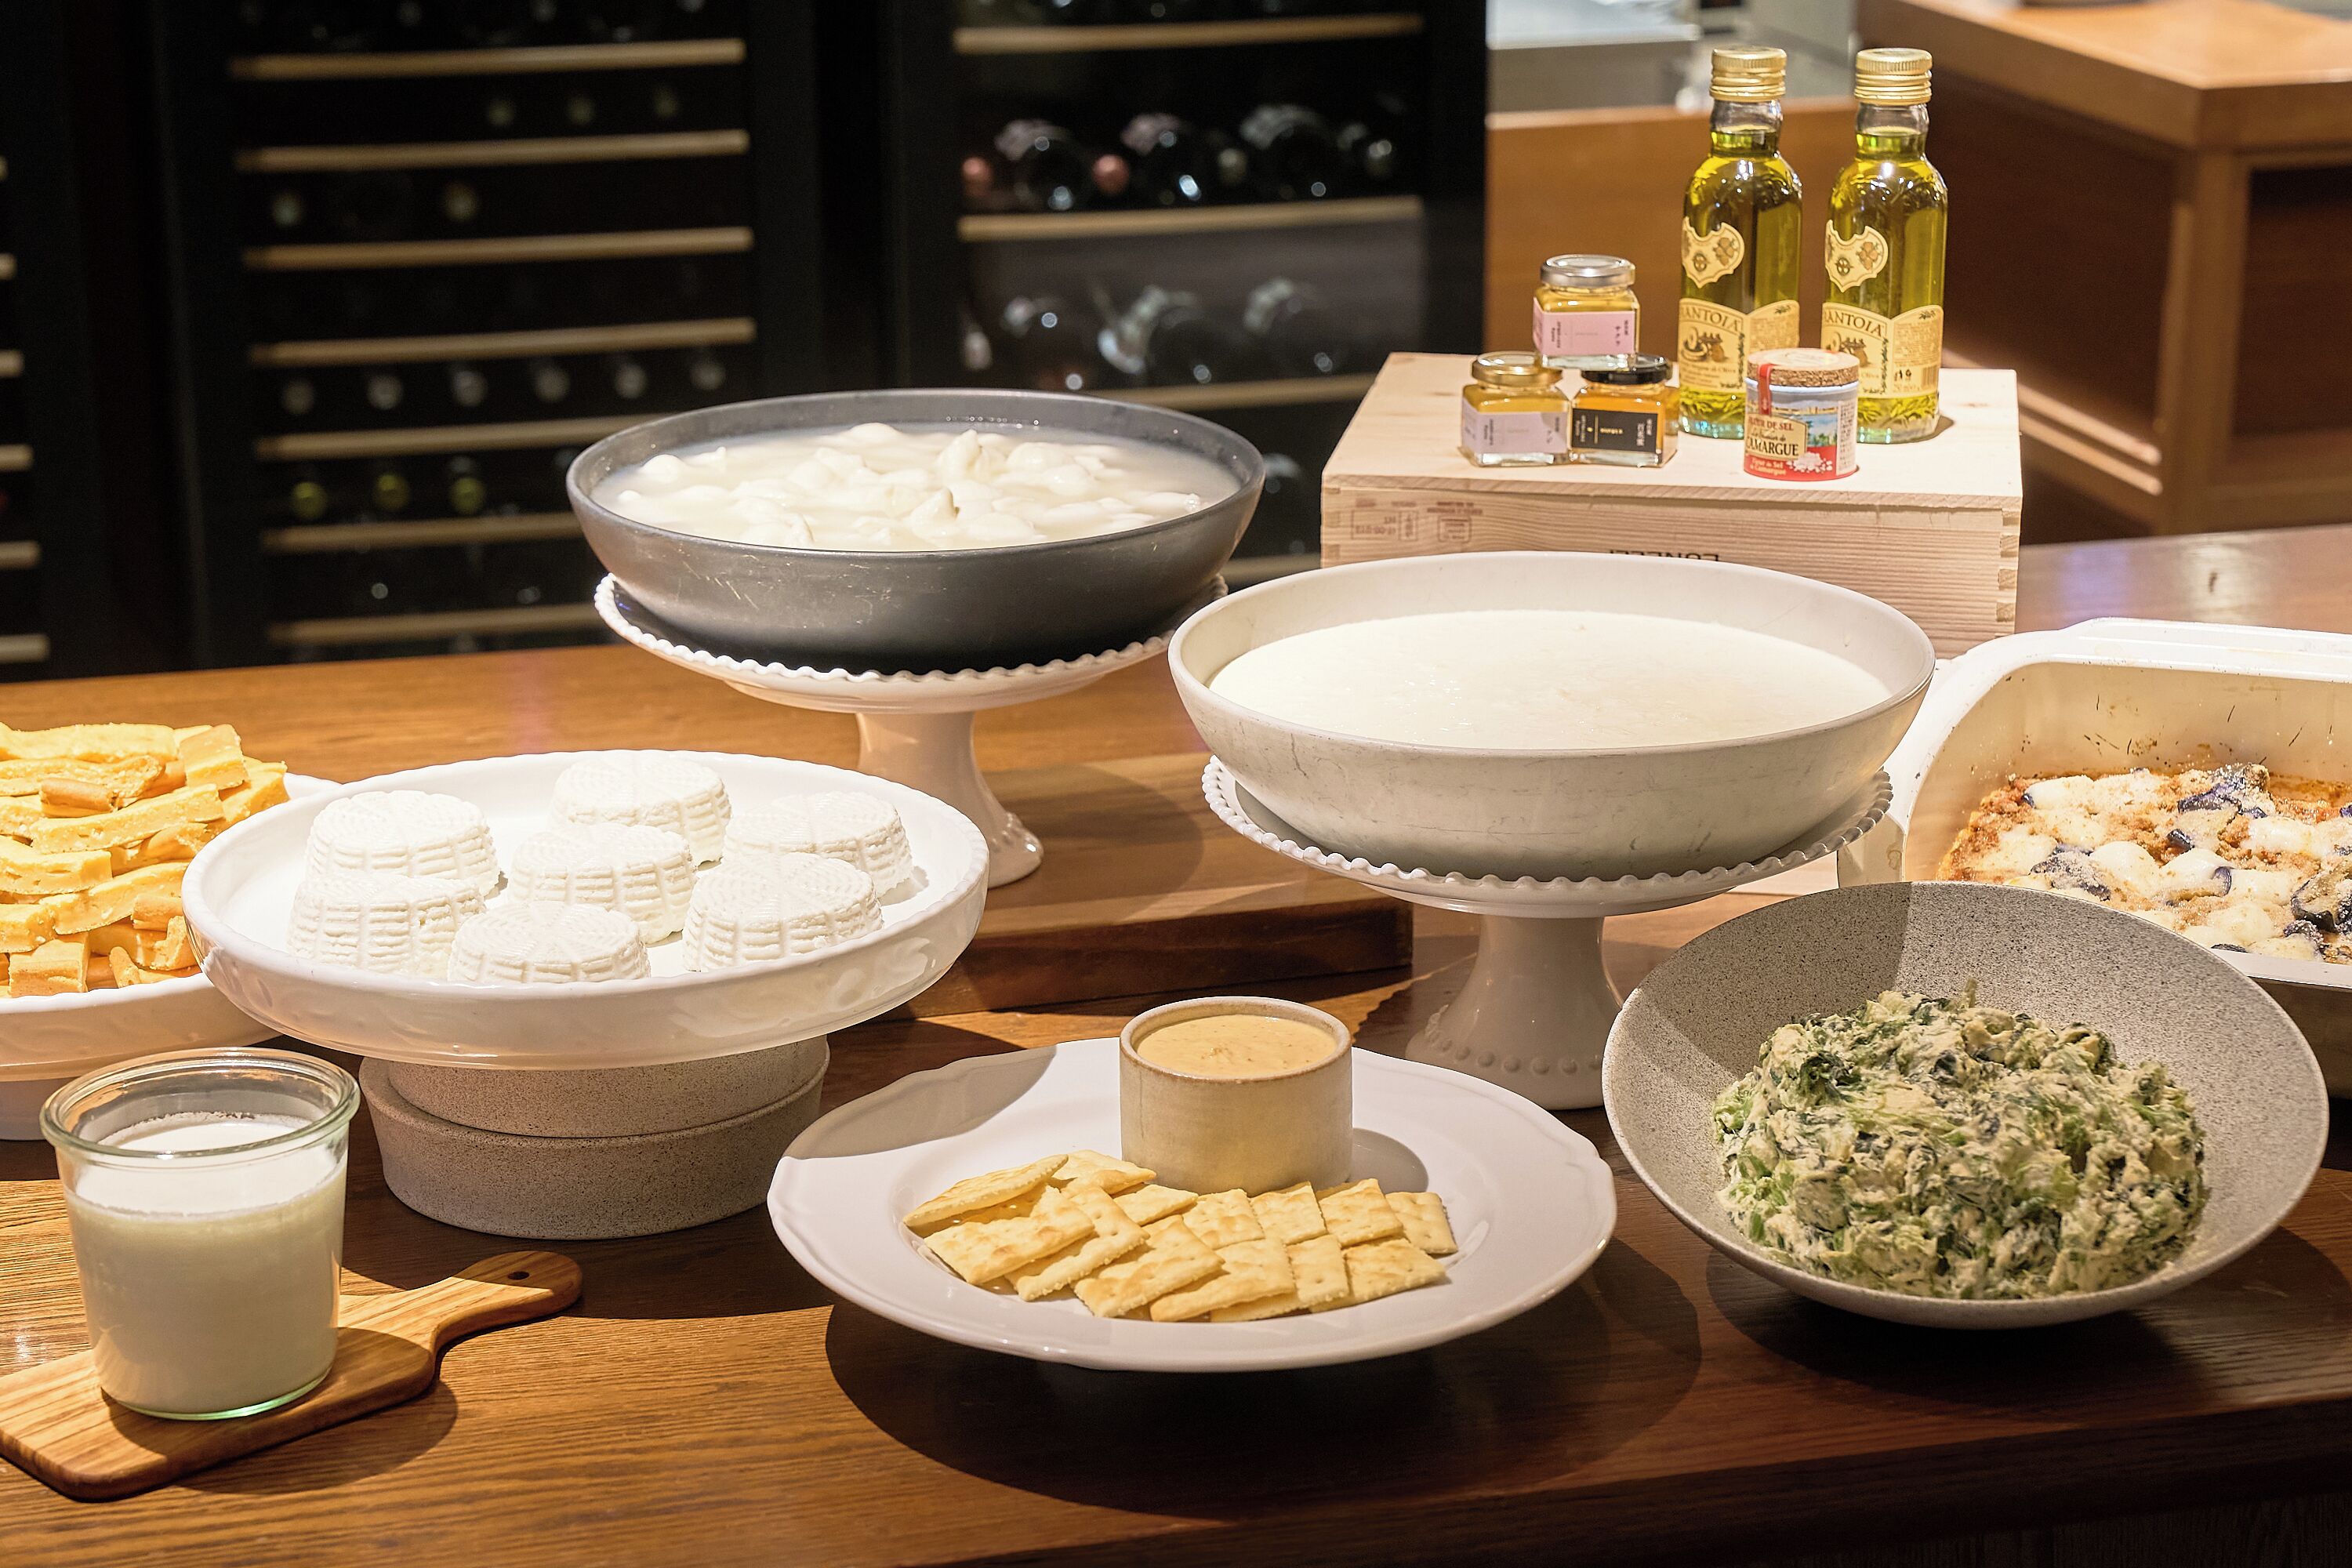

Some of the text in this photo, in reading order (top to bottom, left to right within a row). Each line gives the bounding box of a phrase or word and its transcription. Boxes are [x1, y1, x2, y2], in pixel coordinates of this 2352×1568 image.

[1766, 420, 1777, 430] DE
[1779, 422, 1795, 431] SEL
[1745, 436, 1799, 456] CAMARGUE
